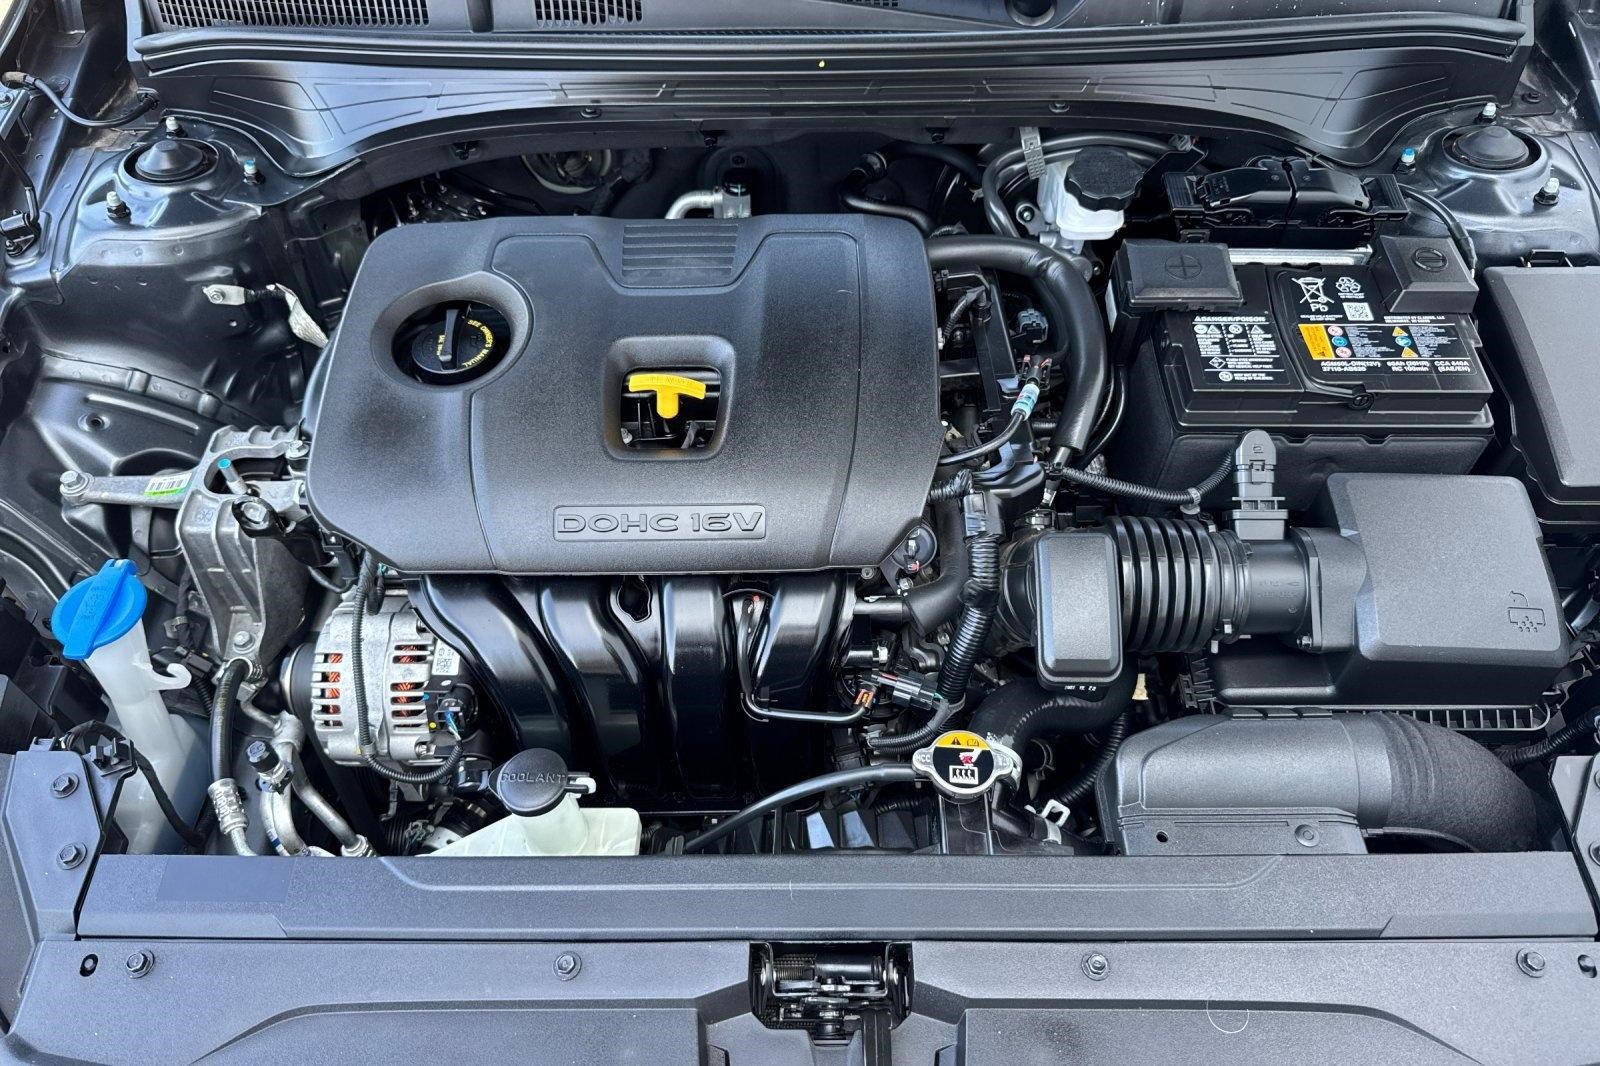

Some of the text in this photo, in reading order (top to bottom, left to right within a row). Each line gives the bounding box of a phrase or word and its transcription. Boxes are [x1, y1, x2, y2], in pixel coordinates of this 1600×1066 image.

[1310, 303, 1328, 312] Pb
[467, 319, 482, 328] SEE
[461, 348, 490, 368] MANUAL
[557, 512, 763, 533] DOHC 16V
[501, 771, 566, 784] COOLANT
